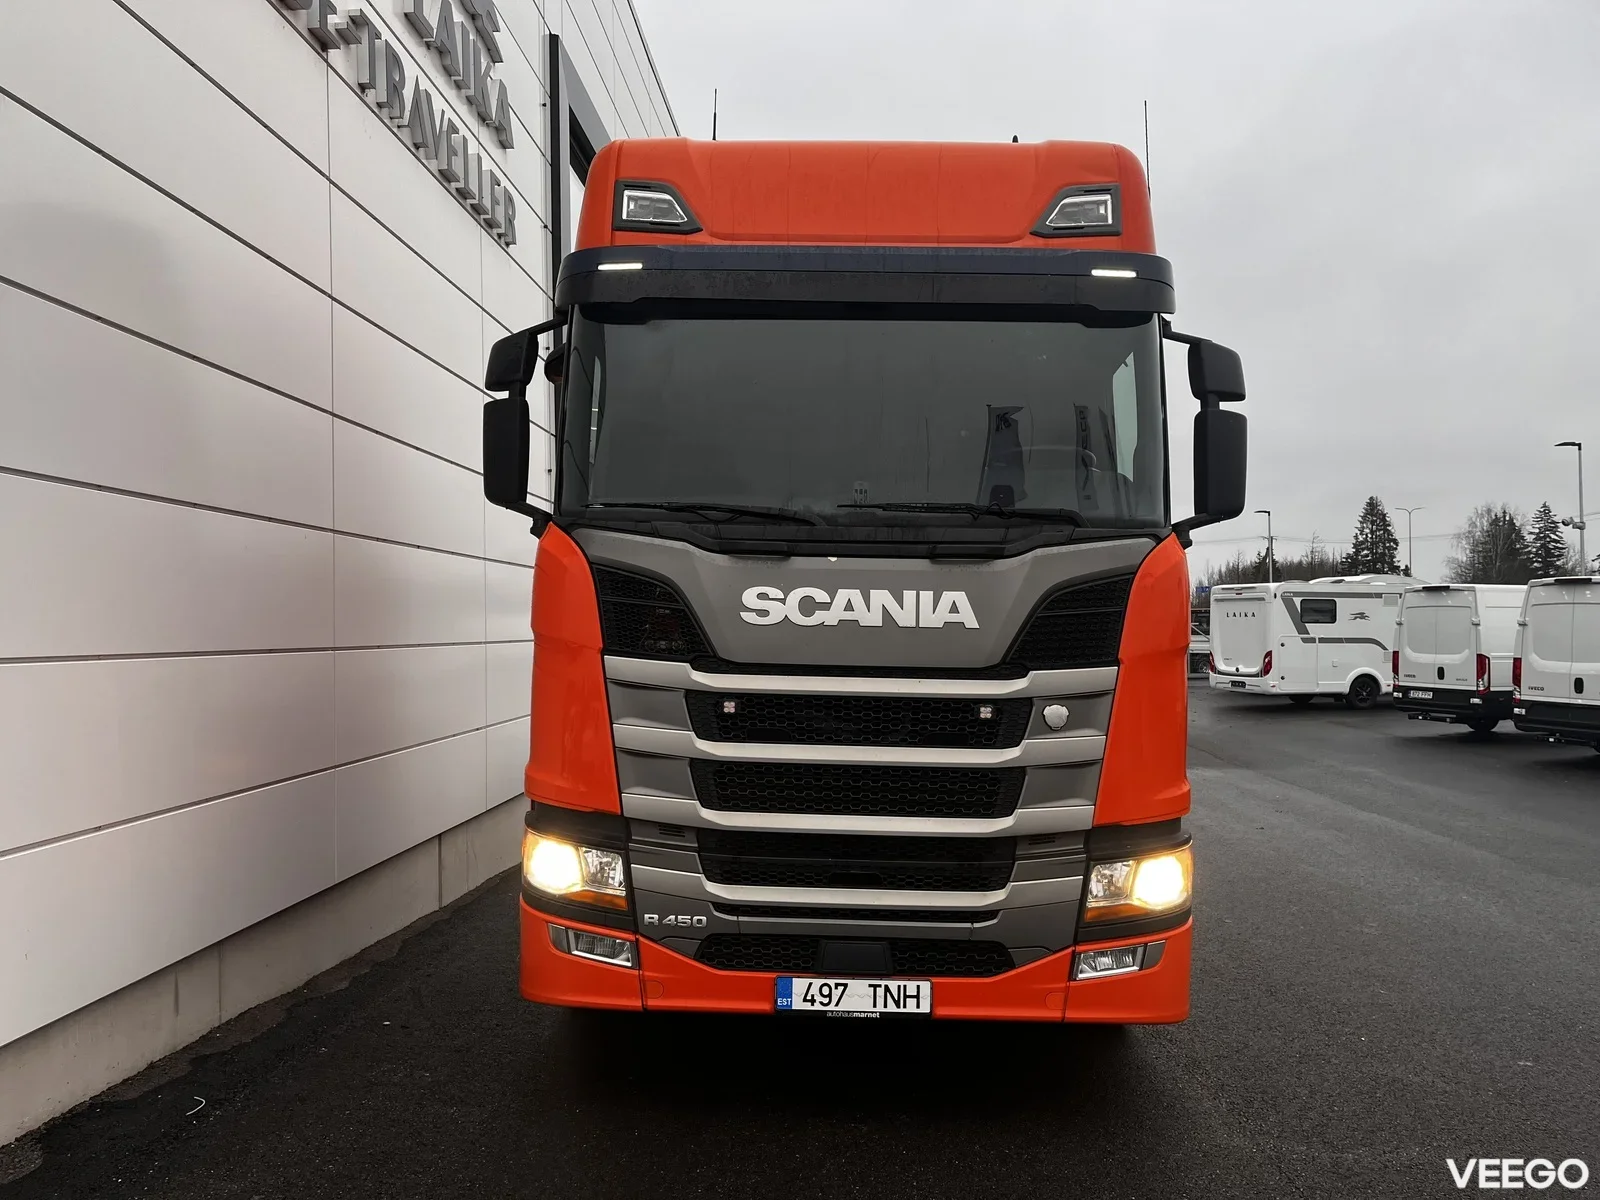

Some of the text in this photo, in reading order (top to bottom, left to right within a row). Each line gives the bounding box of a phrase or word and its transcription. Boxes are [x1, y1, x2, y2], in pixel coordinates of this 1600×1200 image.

[279, 0, 516, 246] E-TRAVELLER
[740, 586, 980, 629] SCANIA
[643, 913, 707, 928] R 450
[777, 998, 792, 1006] EST
[802, 982, 920, 1009] 497 TNH
[826, 1011, 880, 1019] autohausmarnet
